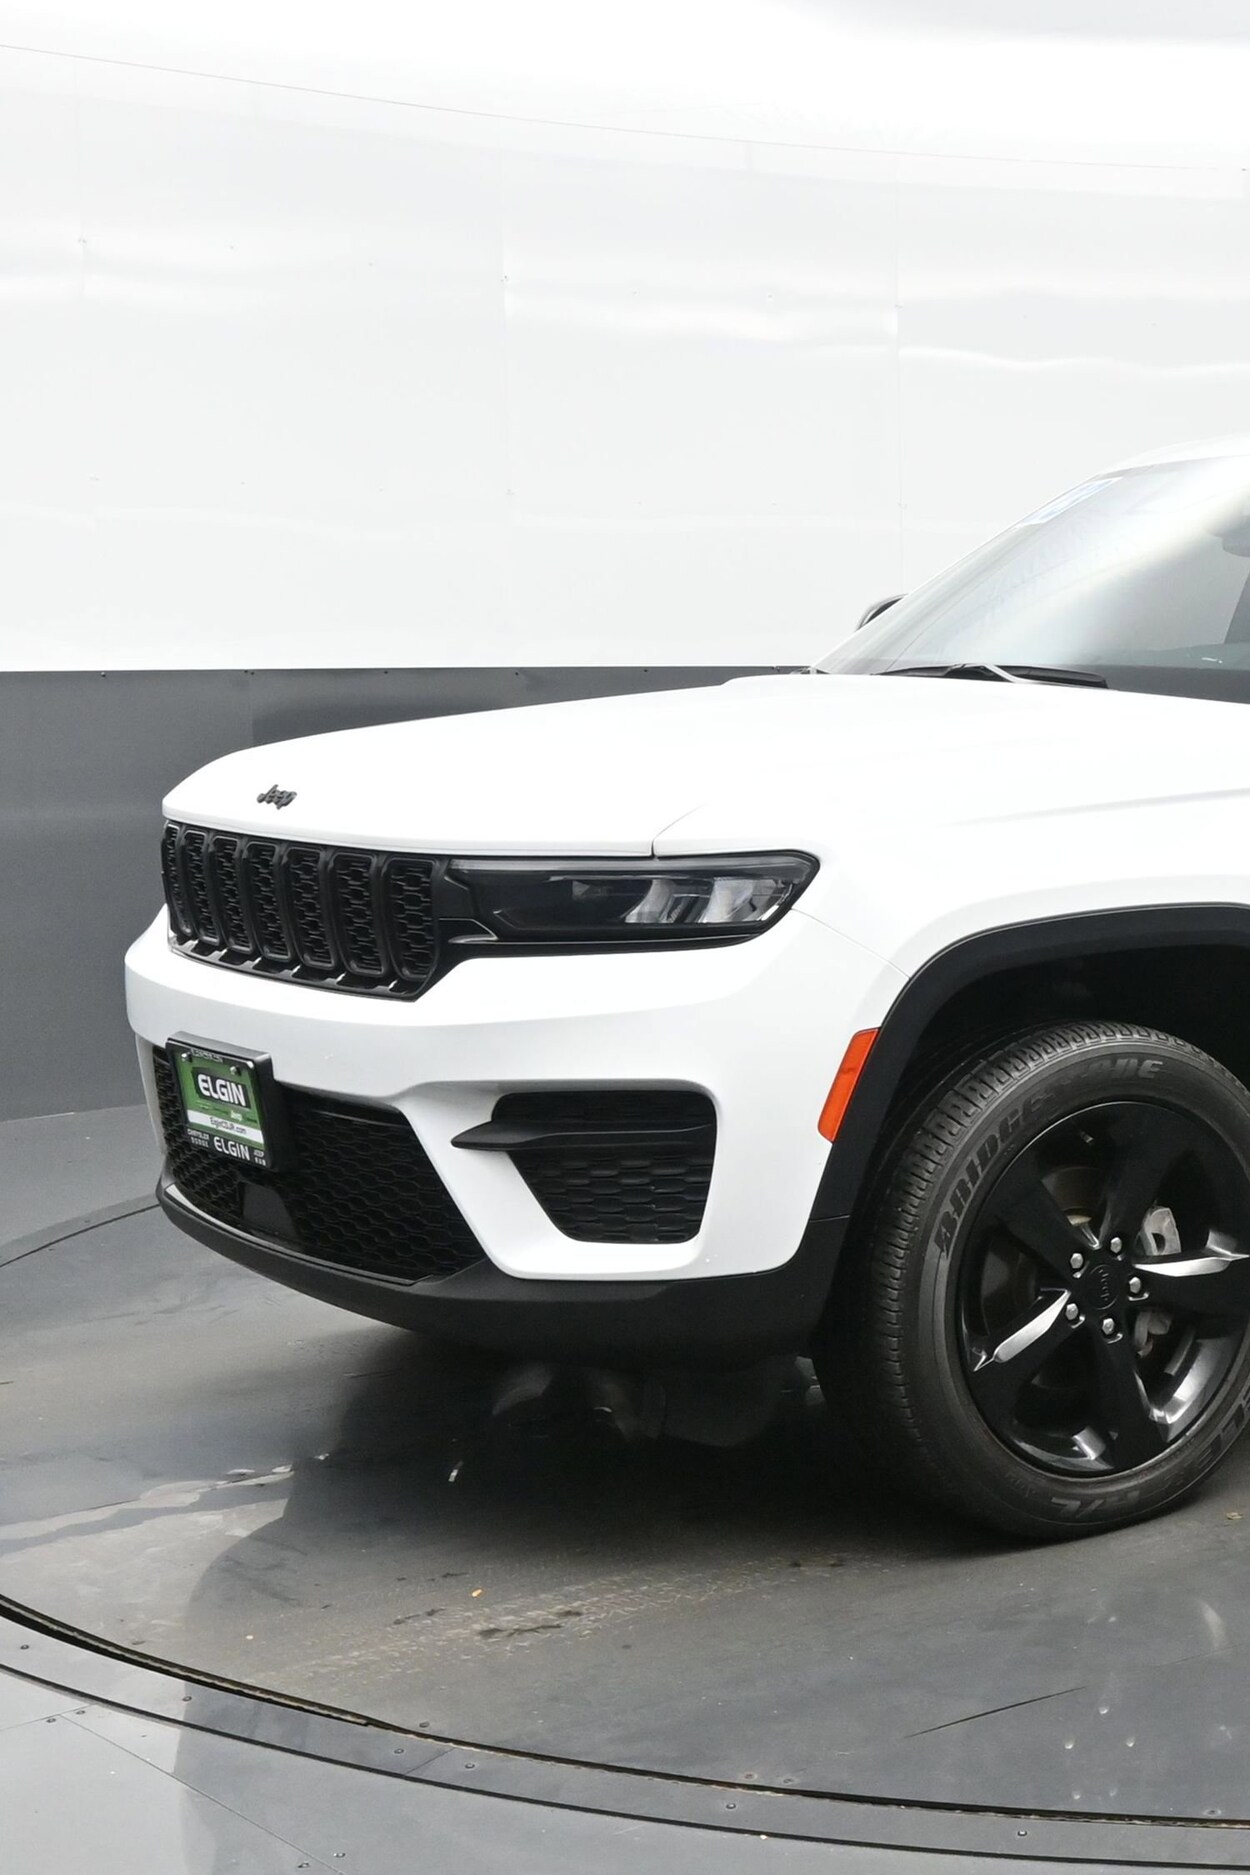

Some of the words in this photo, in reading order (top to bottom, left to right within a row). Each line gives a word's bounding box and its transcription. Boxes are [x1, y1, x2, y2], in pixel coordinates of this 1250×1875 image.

[256, 784, 298, 810] Jeep
[197, 1073, 246, 1107] ELGIN
[213, 1135, 251, 1161] ELGIN
